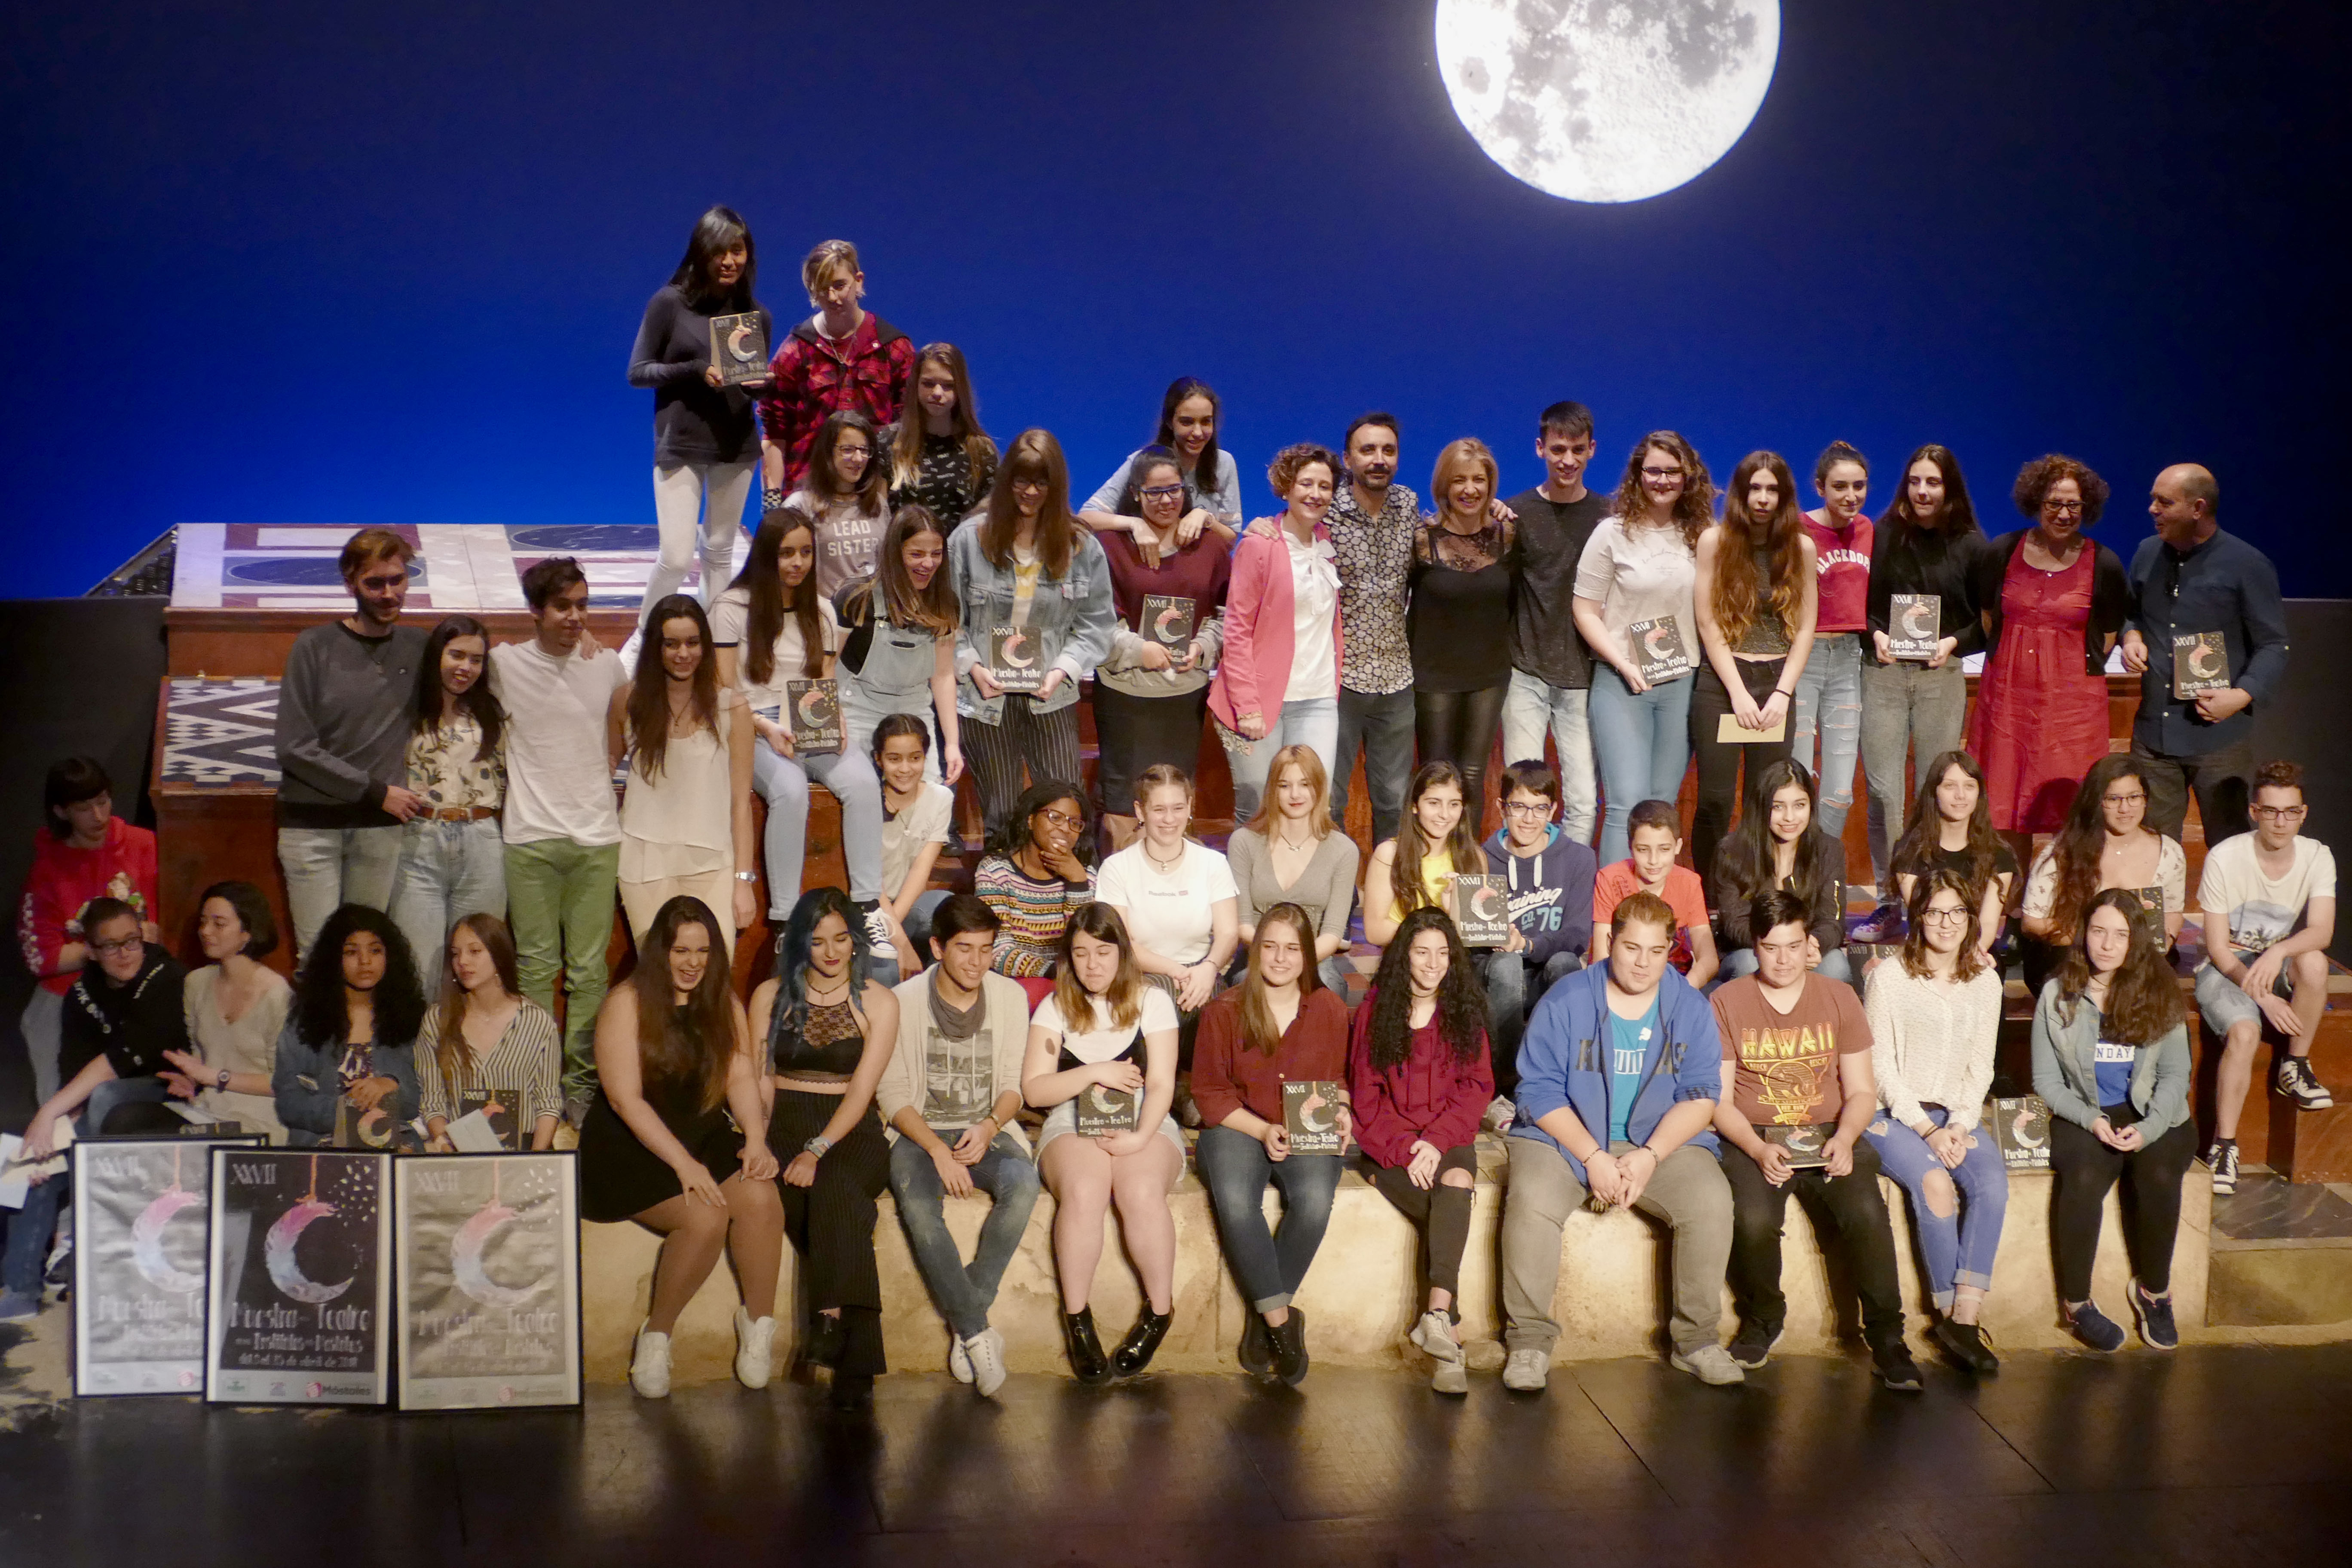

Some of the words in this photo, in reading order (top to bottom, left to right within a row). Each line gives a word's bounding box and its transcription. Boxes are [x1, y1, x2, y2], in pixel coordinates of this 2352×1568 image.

[833, 520, 871, 537] LEAD
[827, 537, 879, 556] SISTER
[992, 627, 1014, 636] XXVII
[2173, 636, 2196, 646] XXVII
[1458, 876, 1480, 886] XXVII
[1507, 886, 1563, 911] raining
[1536, 906, 1563, 932] 76
[1742, 1021, 1834, 1059] HAWAII
[2096, 1047, 2131, 1059] NDAY
